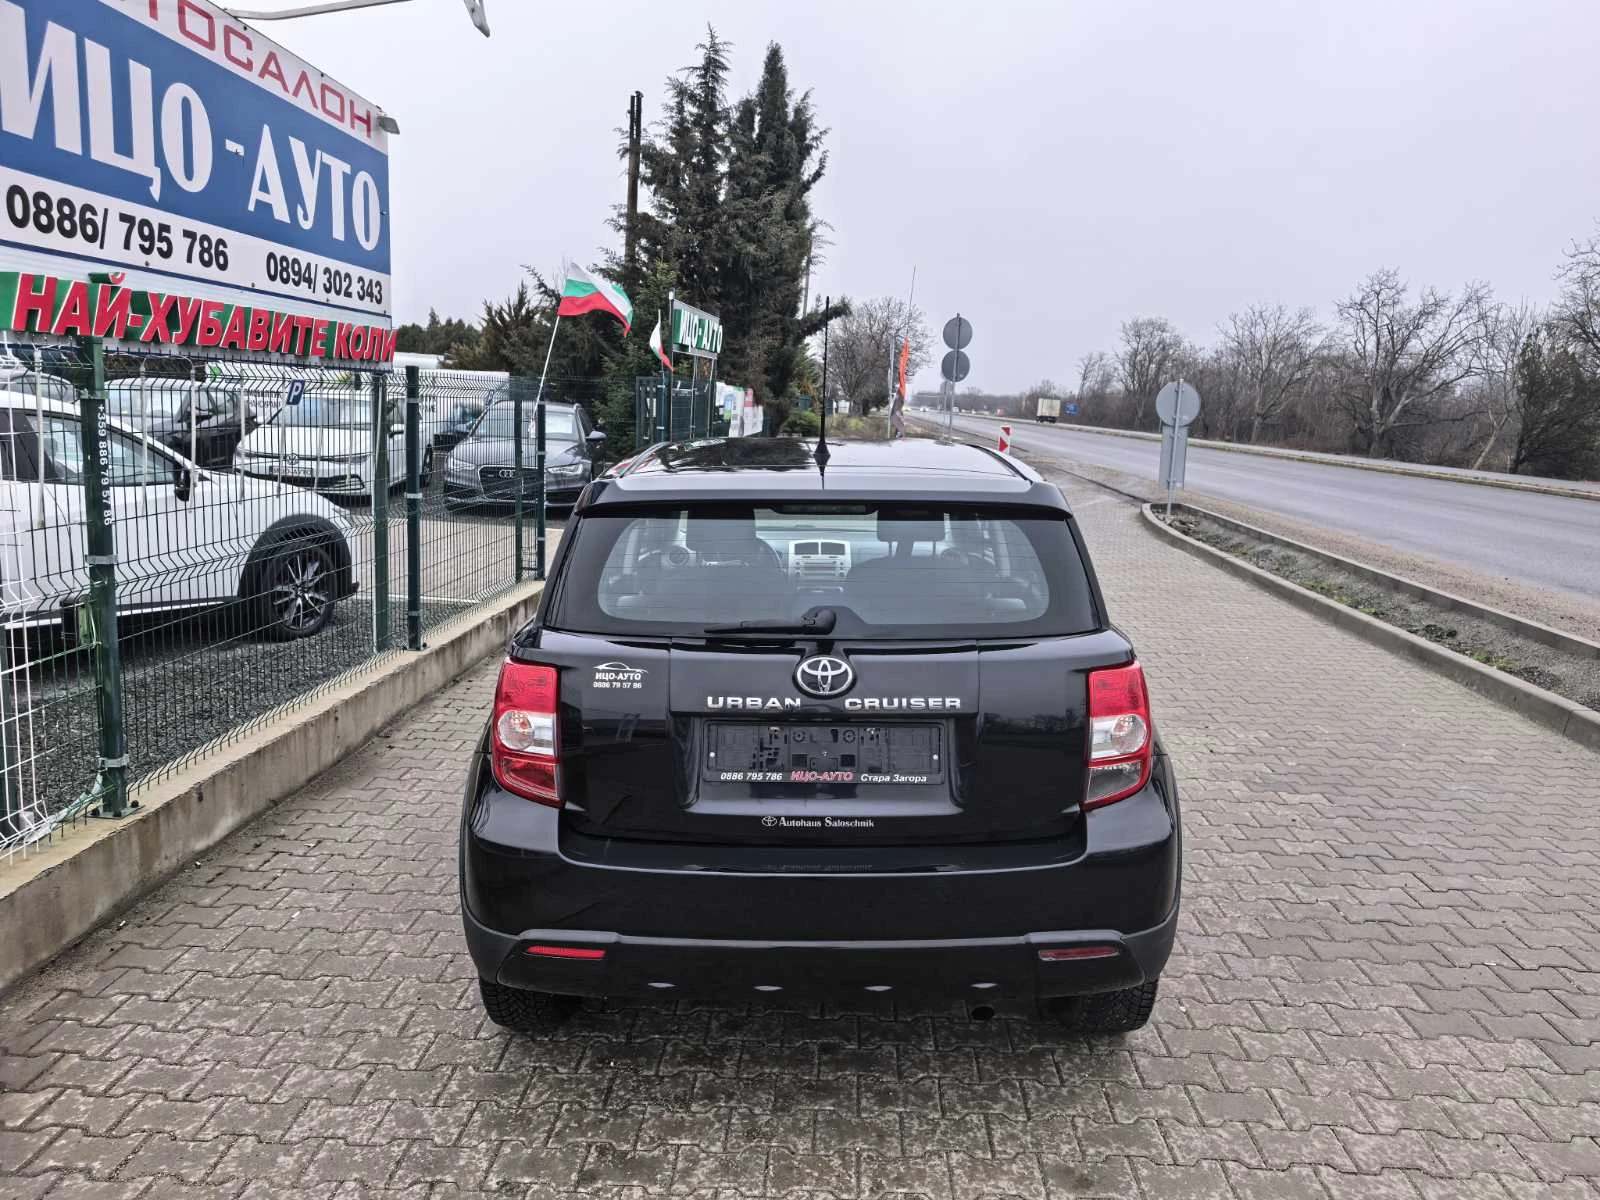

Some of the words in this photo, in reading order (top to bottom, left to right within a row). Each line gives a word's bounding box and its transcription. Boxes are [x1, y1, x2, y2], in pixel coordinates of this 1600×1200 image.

[6, 184, 109, 249] 0886/
[119, 212, 173, 259] 795
[182, 228, 229, 272] 786
[266, 252, 318, 294] 0894/
[323, 266, 353, 299] 302
[357, 276, 383, 305] 343
[11, 271, 330, 358] НАЙ-ХУБАВИТЕ
[333, 321, 398, 362] КОЛИ
[679, 308, 722, 353] ИЦО-АУТО
[98, 404, 106, 437] +359
[99, 441, 108, 465] 886
[102, 469, 109, 485] 79
[102, 489, 111, 505] 57
[103, 509, 112, 526] 86
[595, 672, 641, 681] ИЦО-АУТО
[707, 696, 801, 710] URBAN
[844, 697, 961, 711] CRUISER
[720, 772, 744, 780] 0886
[746, 772, 763, 780] 795
[766, 773, 782, 781] 786
[791, 771, 853, 782] ИЦО-АУТО
[860, 774, 890, 783] Стара
[893, 774, 927, 784] Загора
[780, 816, 821, 827] Autohaus
